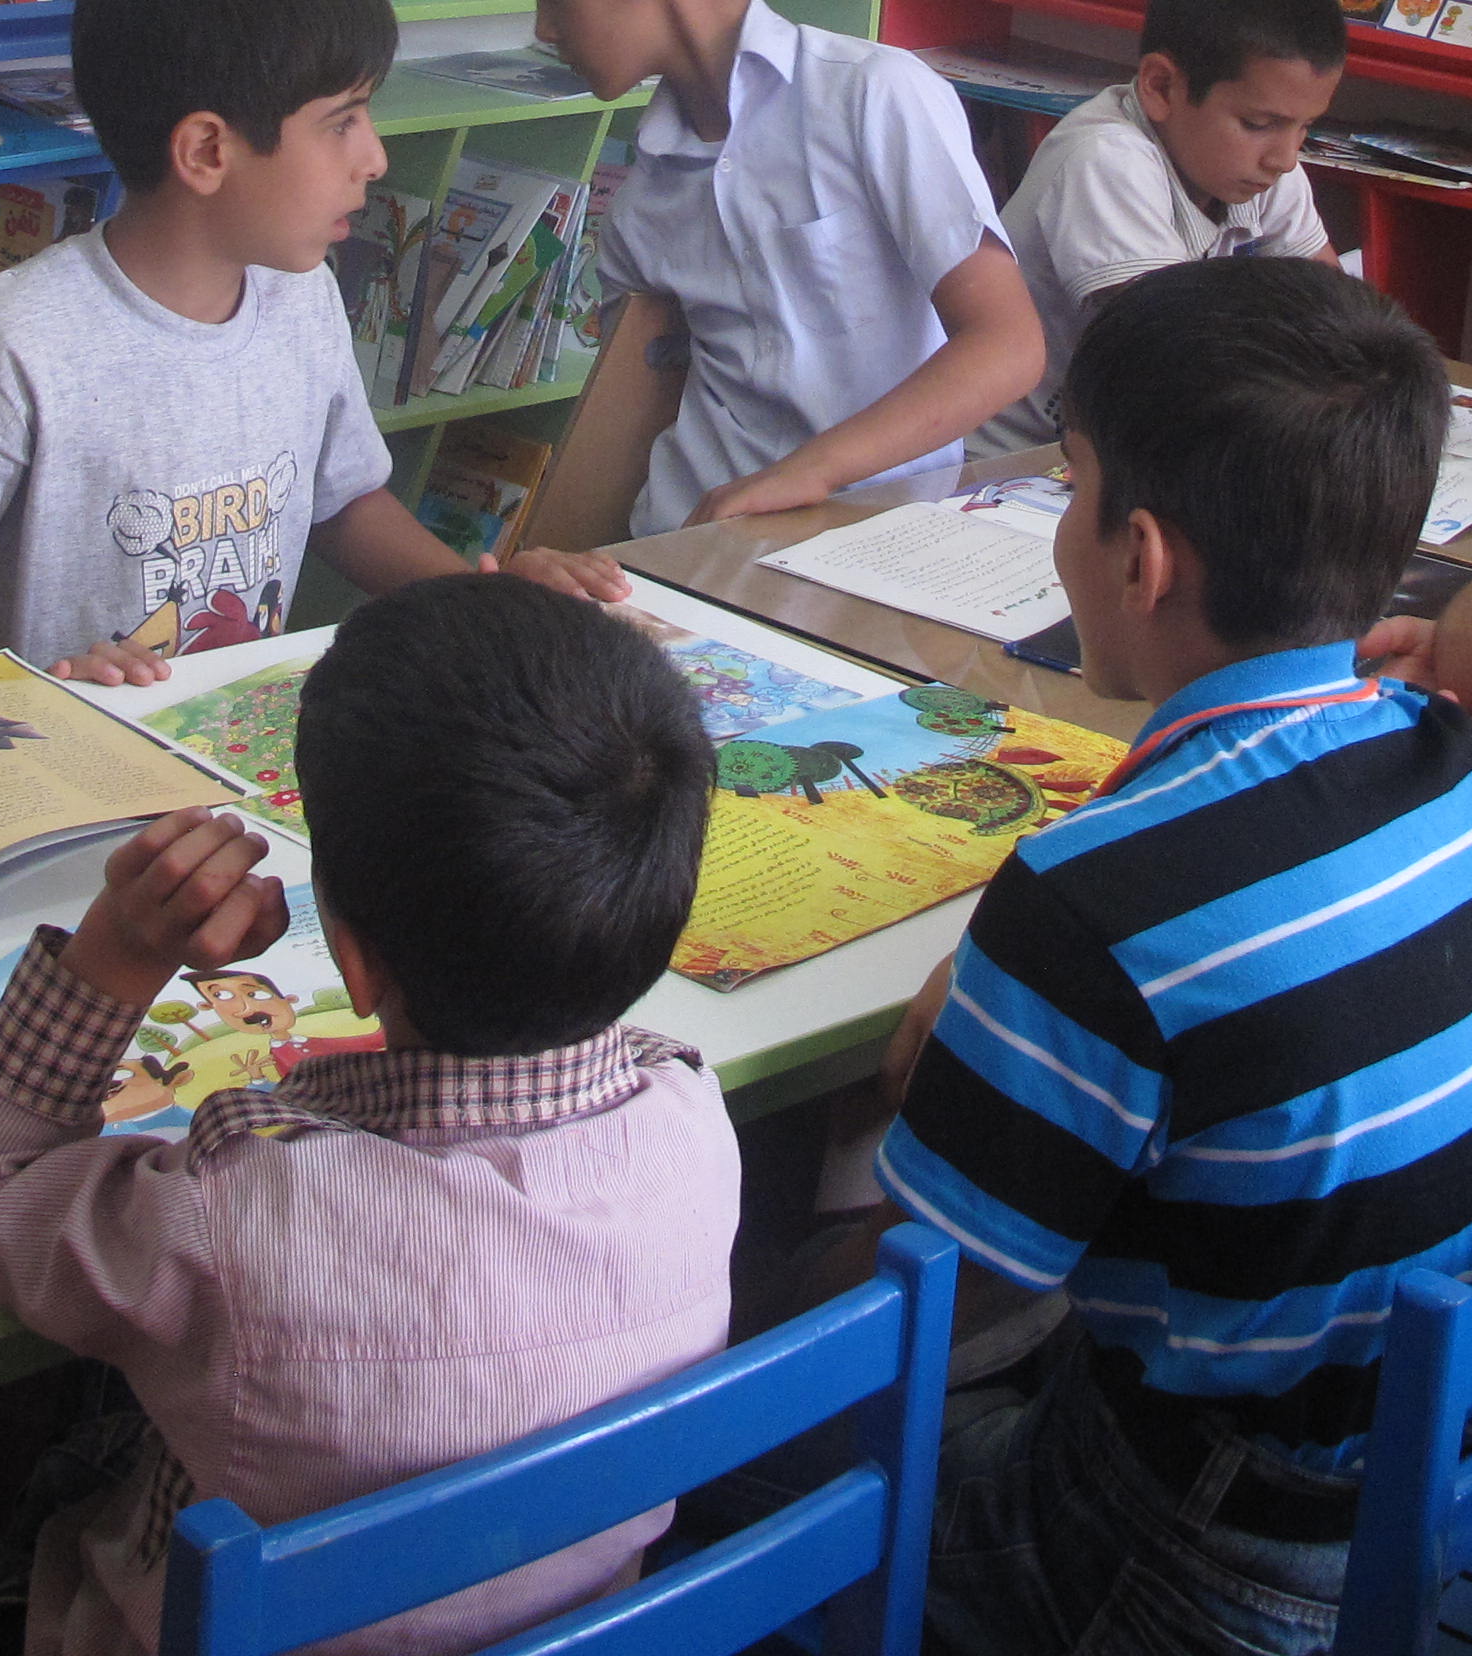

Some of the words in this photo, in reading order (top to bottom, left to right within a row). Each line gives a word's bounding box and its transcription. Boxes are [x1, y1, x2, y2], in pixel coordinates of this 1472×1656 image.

[174, 479, 208, 497] DON'T
[208, 471, 235, 492] CALL
[172, 476, 268, 549] BIRD
